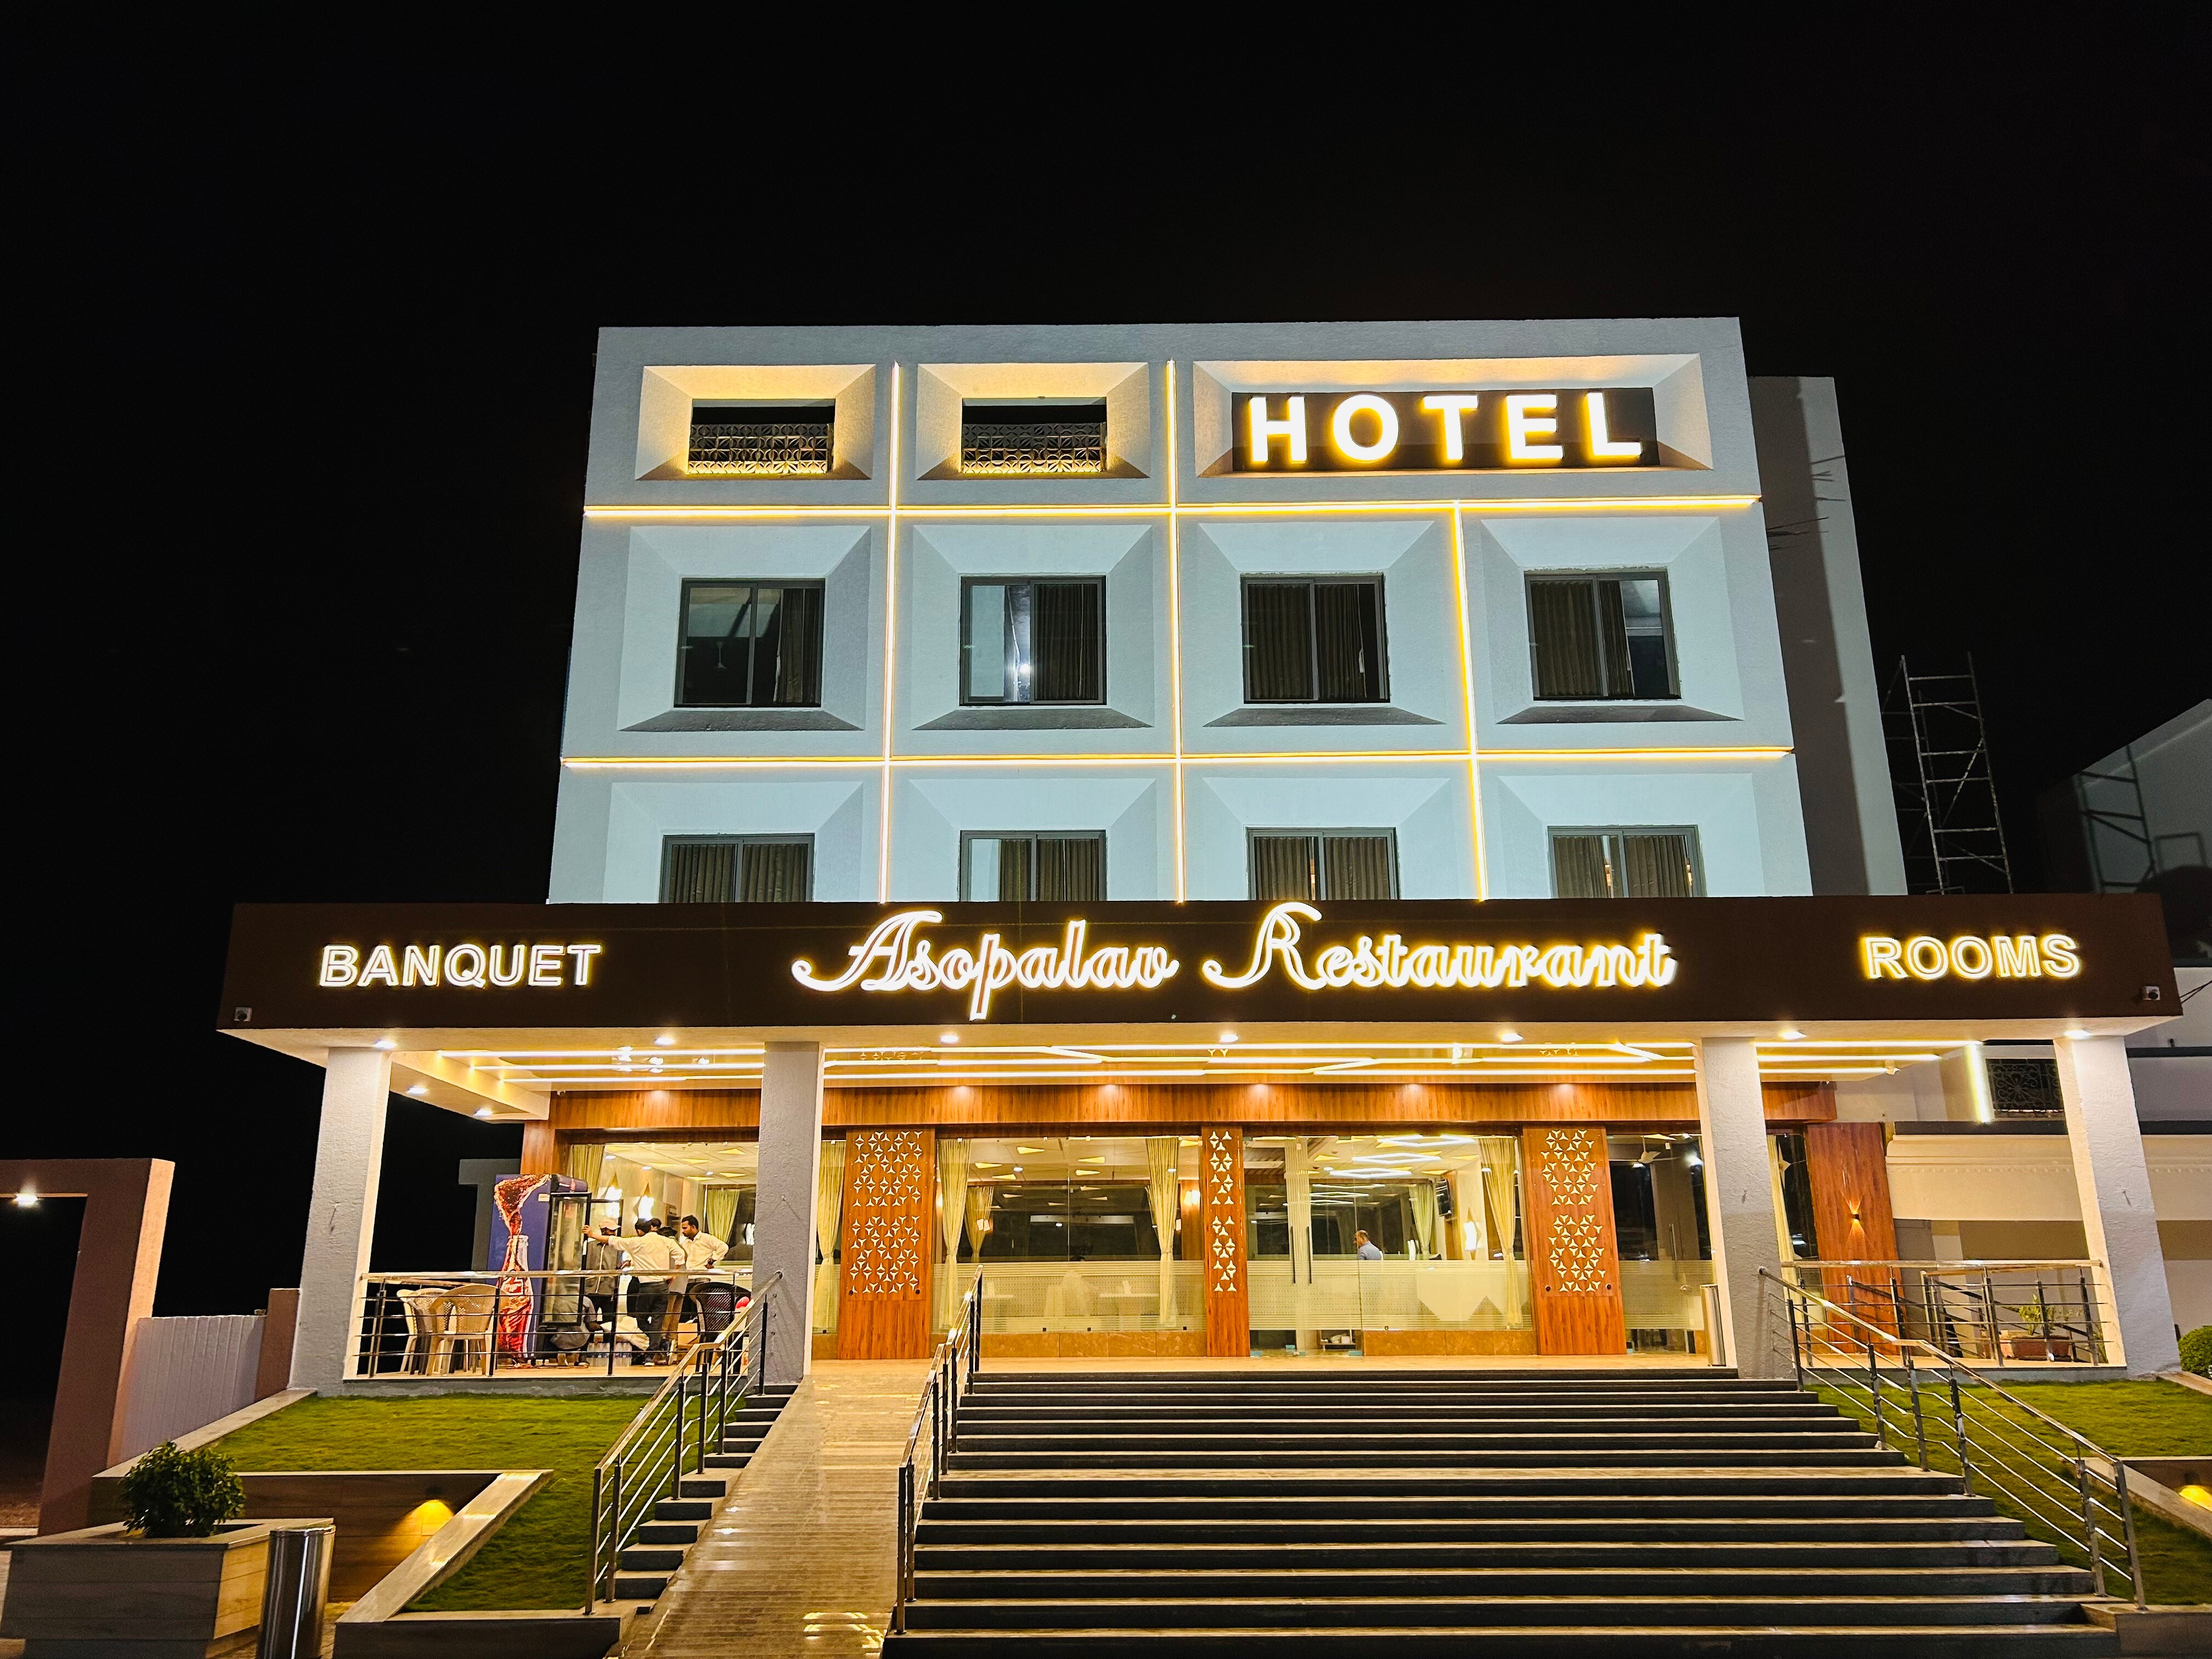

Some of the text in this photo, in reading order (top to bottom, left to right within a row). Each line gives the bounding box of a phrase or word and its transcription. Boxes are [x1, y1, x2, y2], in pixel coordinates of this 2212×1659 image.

[1249, 392, 1643, 464] HOTEL
[319, 944, 602, 988] BANQUET
[791, 901, 1677, 1021] Asopalav Restaurant
[1863, 934, 2080, 980] ROOMS
